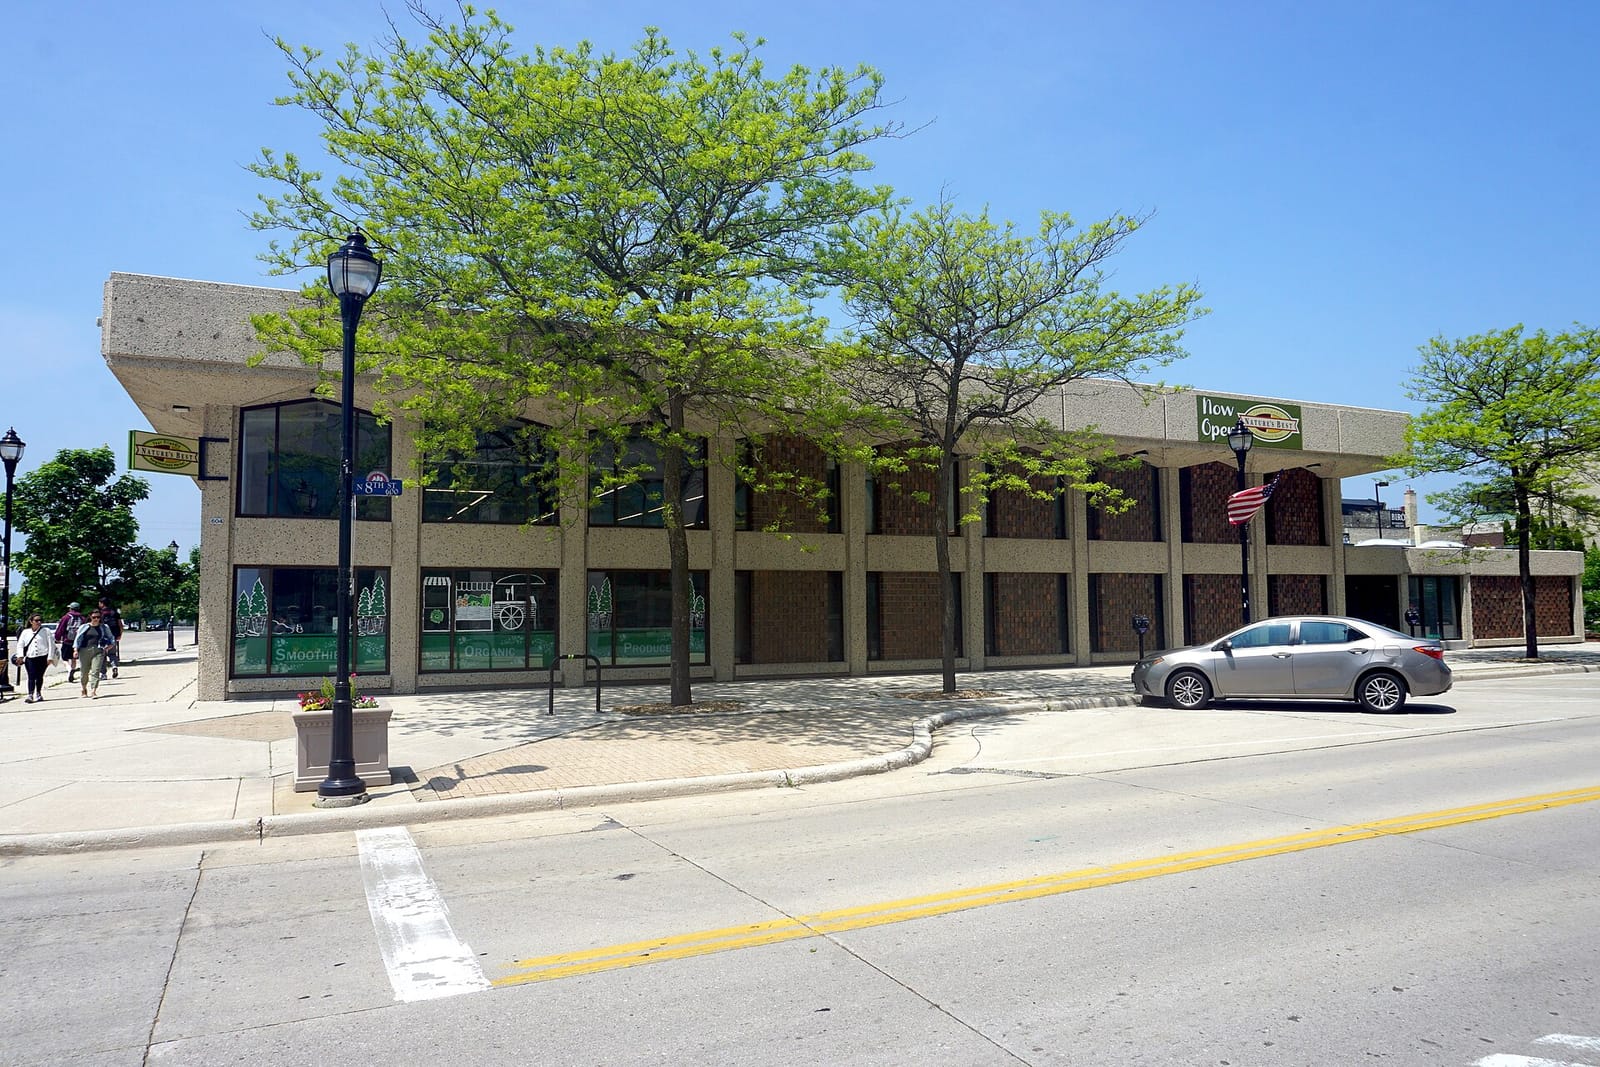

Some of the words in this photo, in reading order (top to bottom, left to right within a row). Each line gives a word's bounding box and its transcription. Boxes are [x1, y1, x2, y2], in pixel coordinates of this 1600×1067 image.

[1202, 396, 1235, 417] Now
[356, 483, 363, 491] N
[464, 645, 516, 657] ORGANIC
[623, 642, 672, 653] PRODUCE
